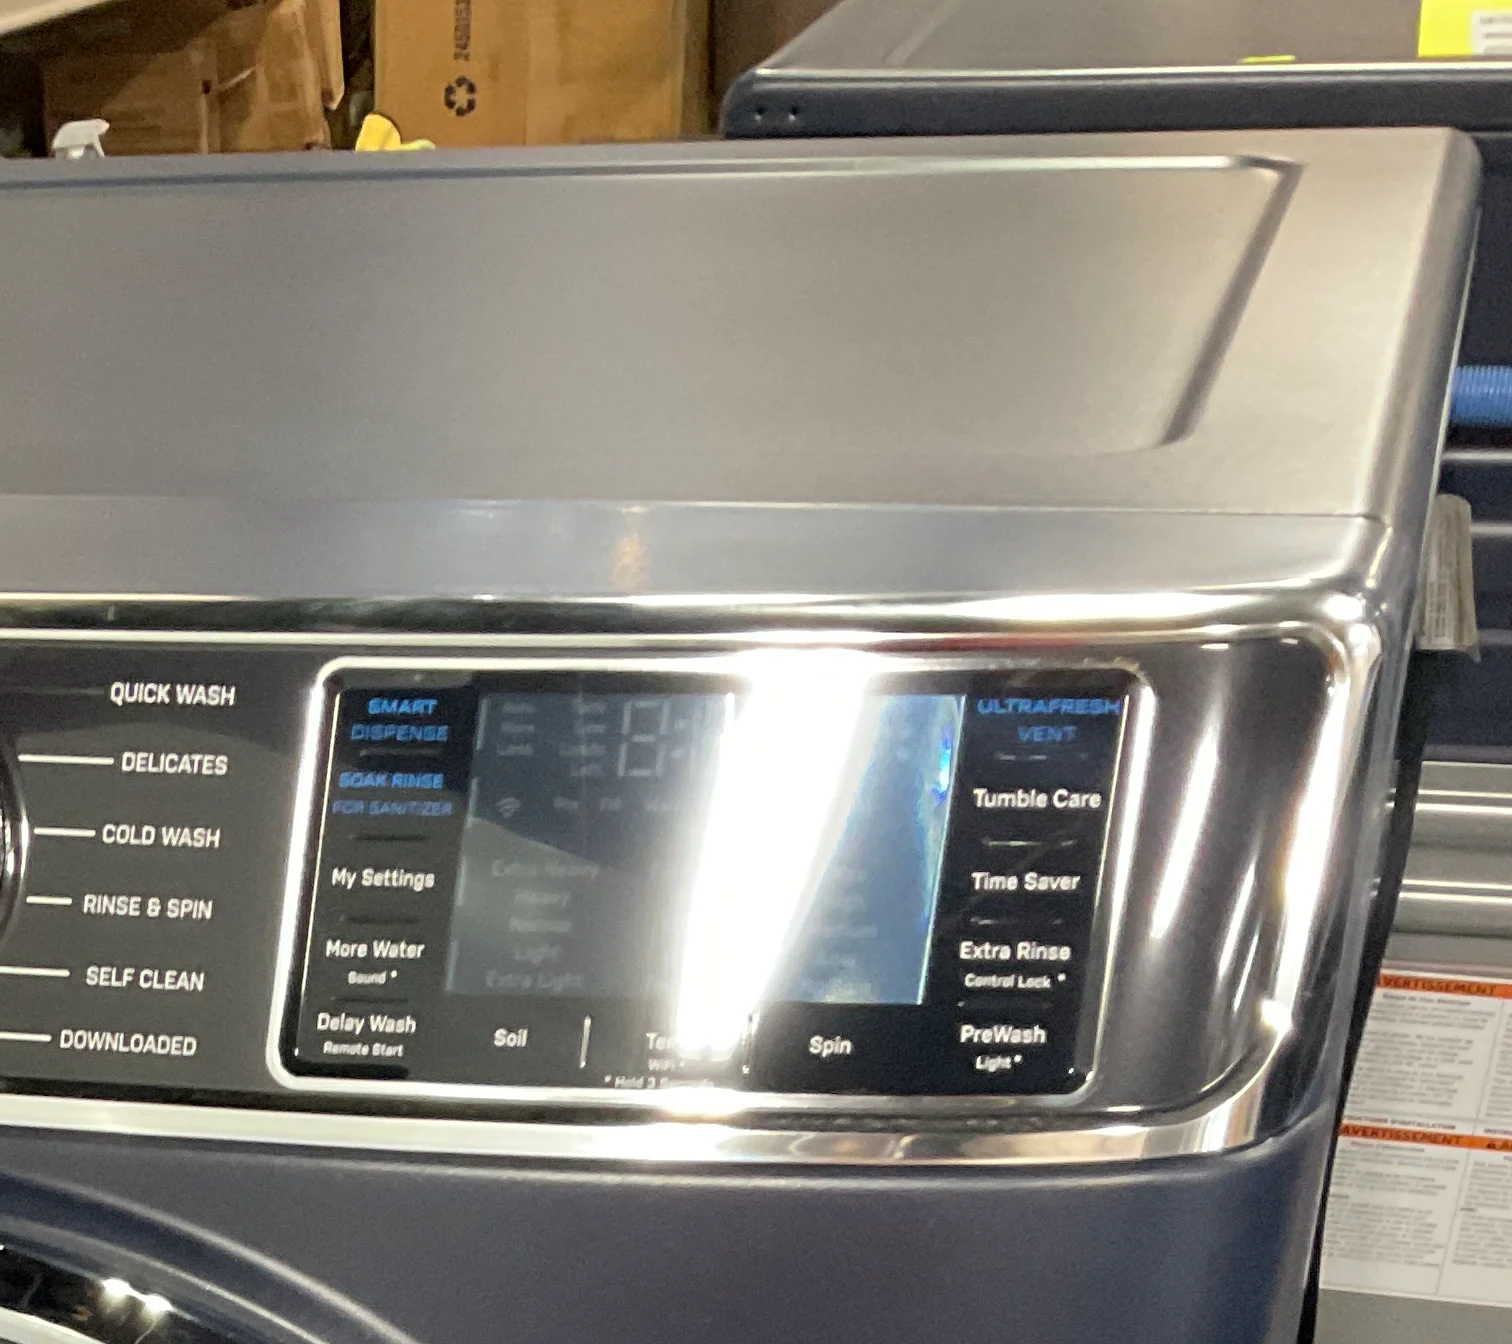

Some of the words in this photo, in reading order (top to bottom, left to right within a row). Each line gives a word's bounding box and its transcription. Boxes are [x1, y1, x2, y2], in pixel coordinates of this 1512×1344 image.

[110, 682, 170, 707] QUICK
[175, 683, 236, 706] WASH
[368, 697, 437, 715] SMART
[977, 698, 1121, 715] ULTRAFRESH
[350, 723, 449, 743] DISPENSE
[1017, 725, 1078, 743] VENT
[121, 751, 228, 776] DELICATES
[339, 771, 387, 788] SOAK
[391, 773, 445, 789] RINSE
[973, 787, 1048, 809] Tumble
[1052, 788, 1102, 809] Care
[102, 824, 155, 845] COLD
[161, 827, 221, 848] WASH
[331, 867, 356, 890] My
[361, 868, 435, 892] Settings
[971, 871, 1018, 891] Time
[1024, 871, 1081, 891] Saver
[83, 894, 141, 917] RINSE
[147, 897, 161, 917] &
[166, 898, 213, 920] SPIN
[326, 939, 368, 958] More
[373, 939, 425, 959] Water
[959, 941, 1011, 961] Extra
[1016, 942, 1071, 961] Rinse
[86, 965, 135, 988] SELF
[139, 969, 204, 992] CLEAN
[347, 970, 387, 985] Sound
[964, 972, 1015, 989] Control
[1017, 975, 1051, 989] Lock
[1381, 974, 1497, 997] VERTISSEMENT
[316, 1012, 365, 1035] Delay
[370, 1014, 417, 1034] Wash
[59, 1029, 197, 1056] DOWNLOADED
[493, 1028, 528, 1047] Soil
[960, 1024, 1047, 1044] PreWash
[323, 1040, 369, 1056] Remote
[371, 1043, 404, 1057] Start
[809, 1035, 852, 1058] Spin
[975, 1054, 1012, 1073] Light
